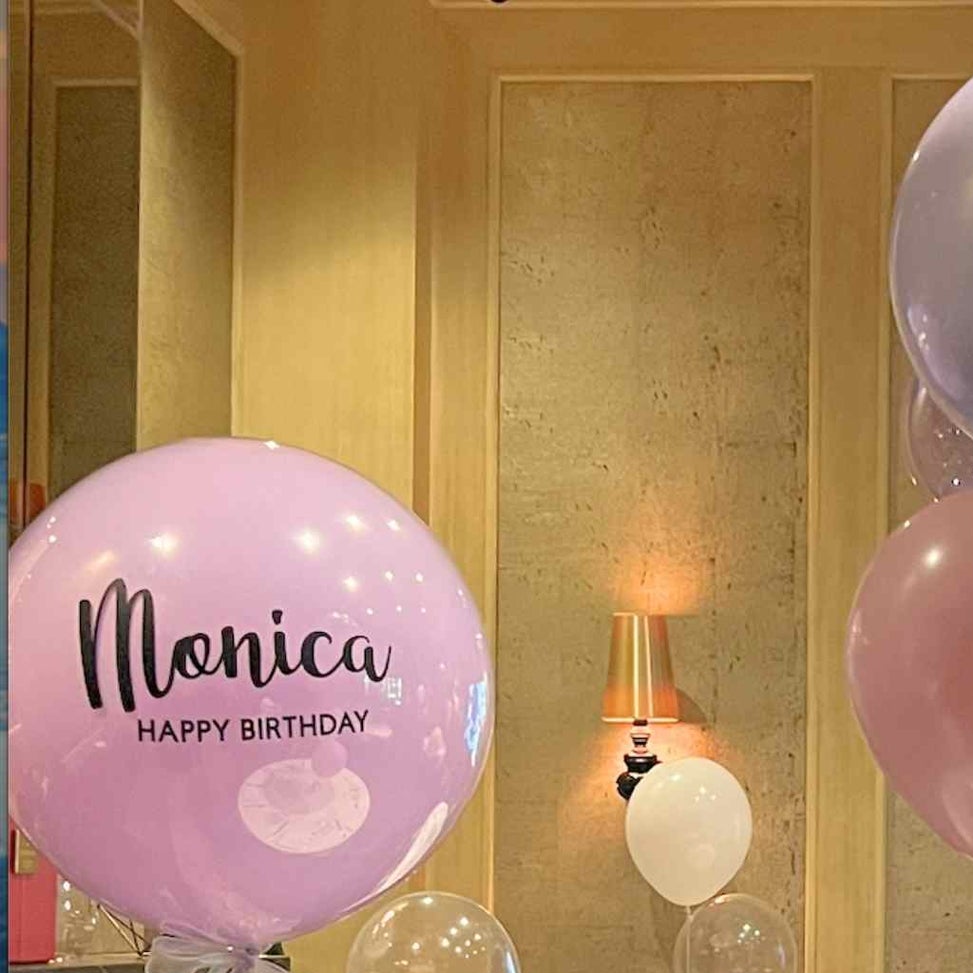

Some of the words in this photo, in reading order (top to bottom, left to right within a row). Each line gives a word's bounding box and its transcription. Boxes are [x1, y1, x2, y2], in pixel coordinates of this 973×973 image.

[79, 578, 392, 712] Monica
[137, 718, 231, 743] HAPPY
[241, 709, 369, 741] BIRTHDAY
